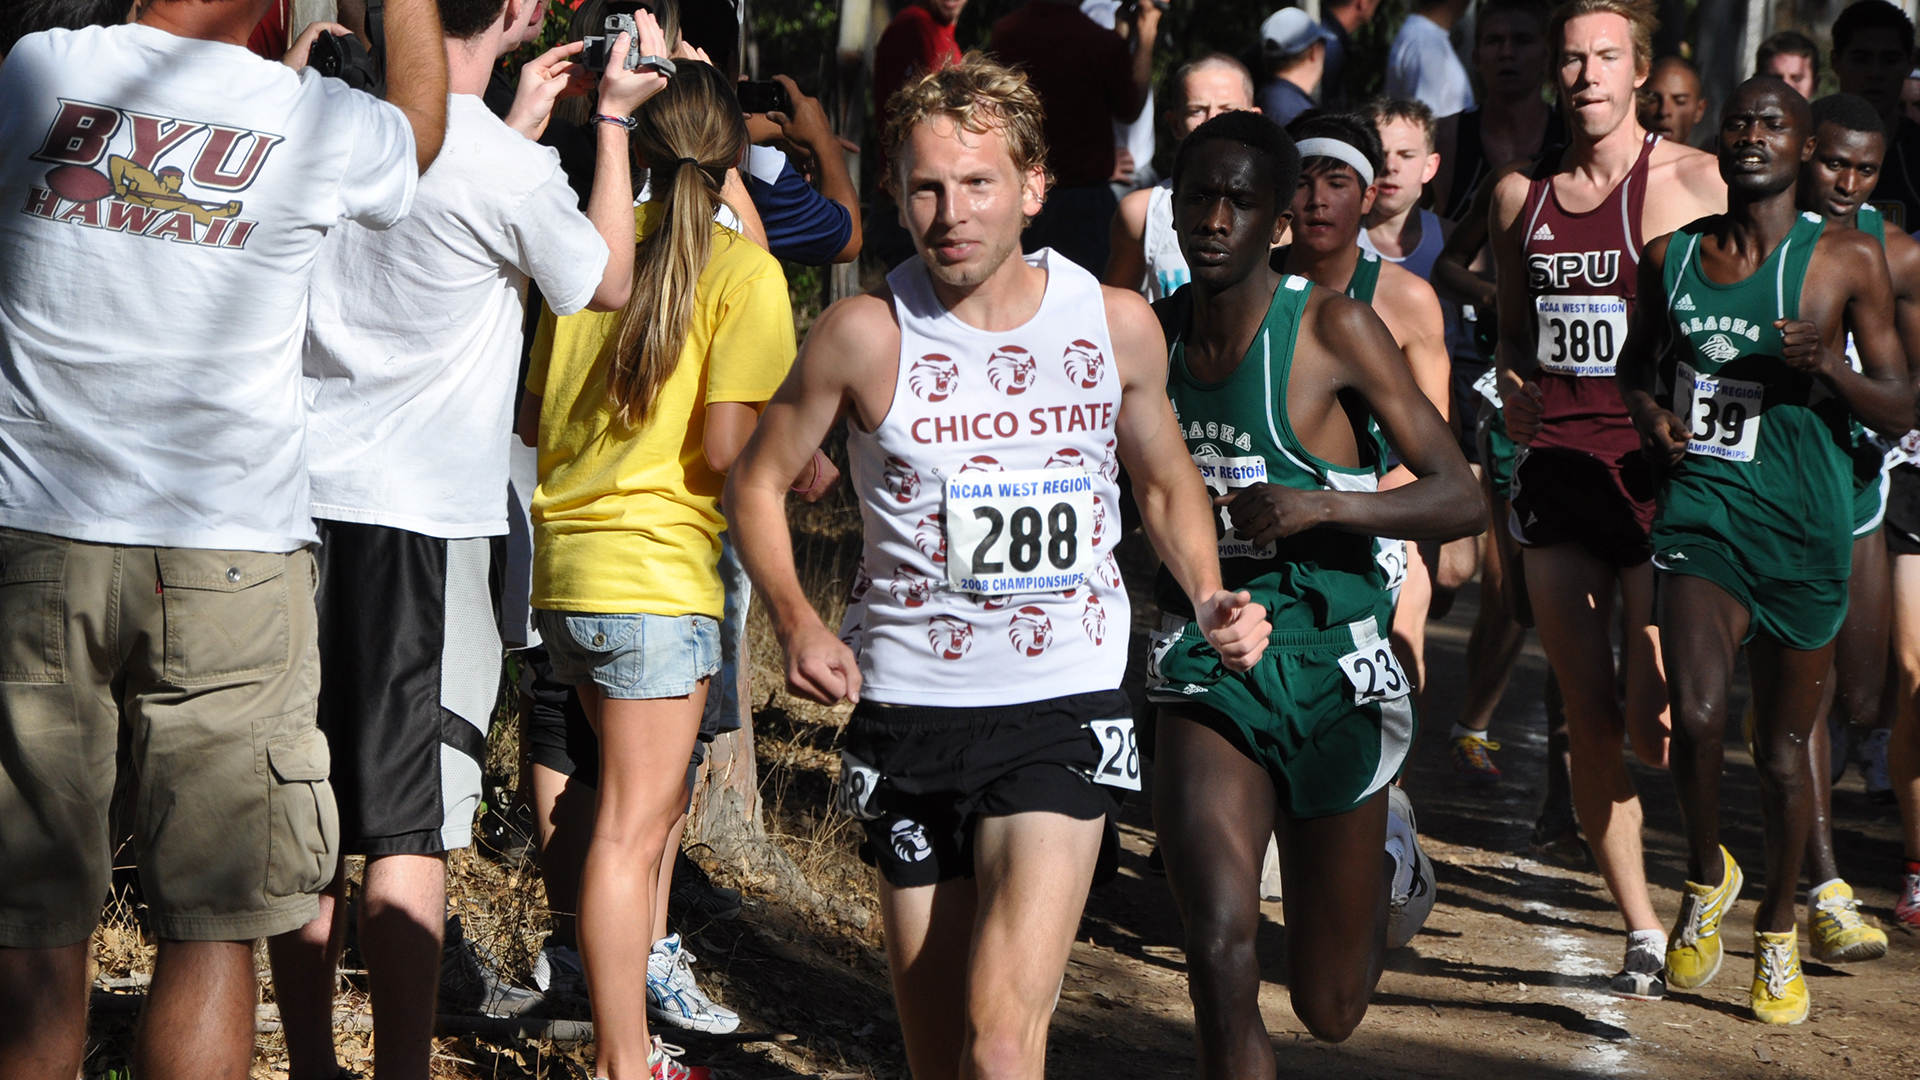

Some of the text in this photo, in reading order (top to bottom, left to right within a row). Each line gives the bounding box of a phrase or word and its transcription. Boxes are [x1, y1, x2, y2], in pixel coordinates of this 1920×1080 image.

[29, 97, 286, 193] BYU
[20, 185, 258, 249] HAWAII
[1527, 250, 1621, 289] SPU
[1539, 303, 1625, 313] NCAA WEST REGION
[1550, 318, 1615, 363] 380
[1680, 316, 1761, 342] ALASKA
[1562, 365, 1617, 374] CHAMPIONSHIP
[1721, 385, 1762, 400] REGION
[911, 402, 1113, 445] CHICO STATE
[1179, 421, 1252, 452] LASKA
[1687, 442, 1746, 459] AMPIONSHIPS
[1220, 464, 1265, 480] REGION
[950, 476, 1092, 500] NCAA WEST REGION
[972, 502, 1078, 575] 288
[961, 572, 1084, 592] 2008 CHAMPIONSHIPS
[1354, 649, 1409, 699] 23
[1102, 726, 1139, 780] 28
